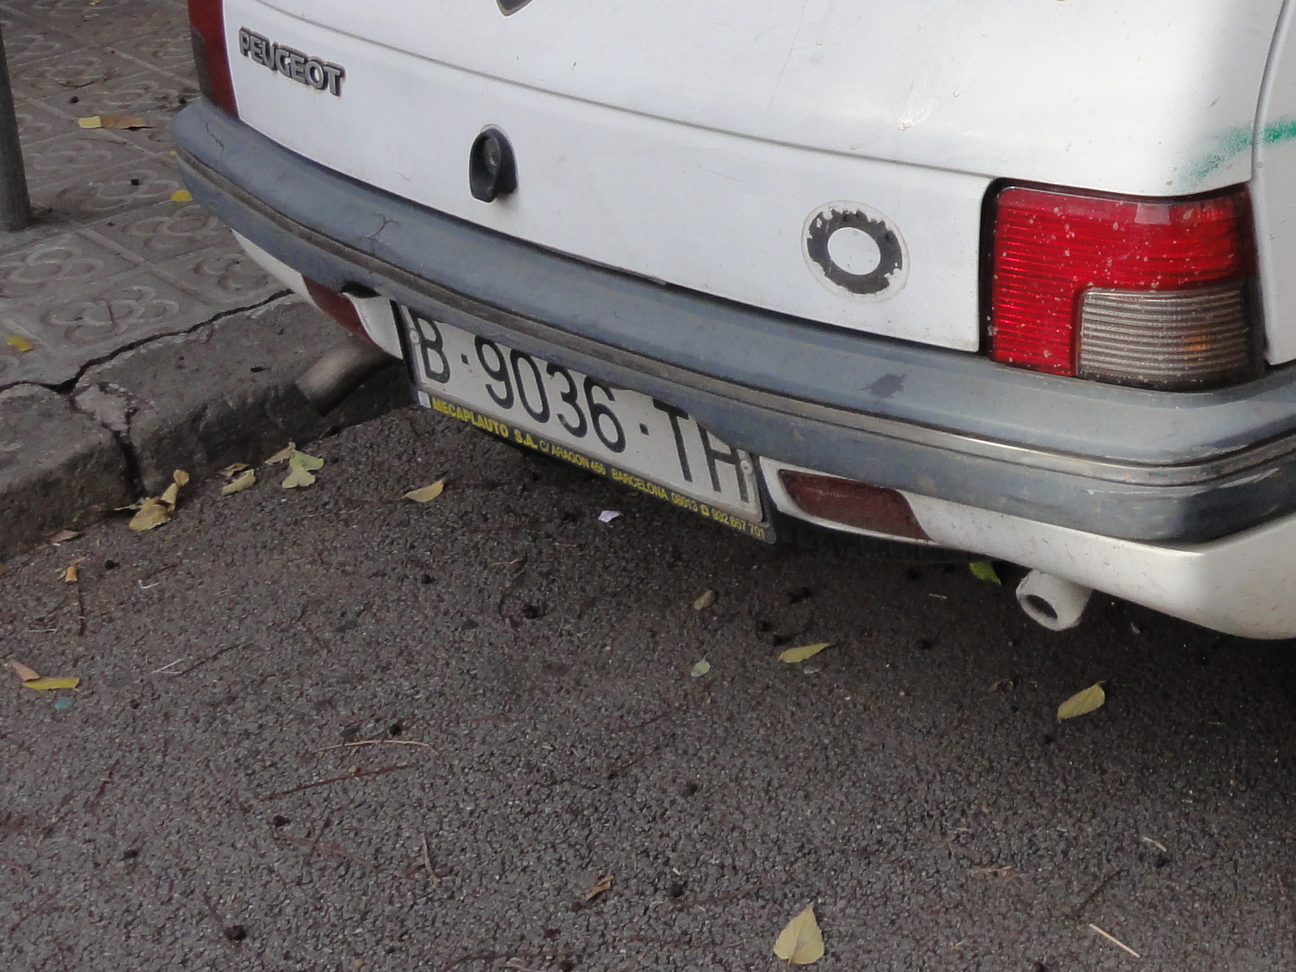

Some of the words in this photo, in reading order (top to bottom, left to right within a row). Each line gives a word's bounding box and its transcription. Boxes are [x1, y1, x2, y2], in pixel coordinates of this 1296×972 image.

[239, 26, 345, 97] PEUGEOT
[431, 397, 509, 438] MECAPLAUTO
[514, 429, 538, 449] S.A.
[611, 468, 669, 500] BARCELONA
